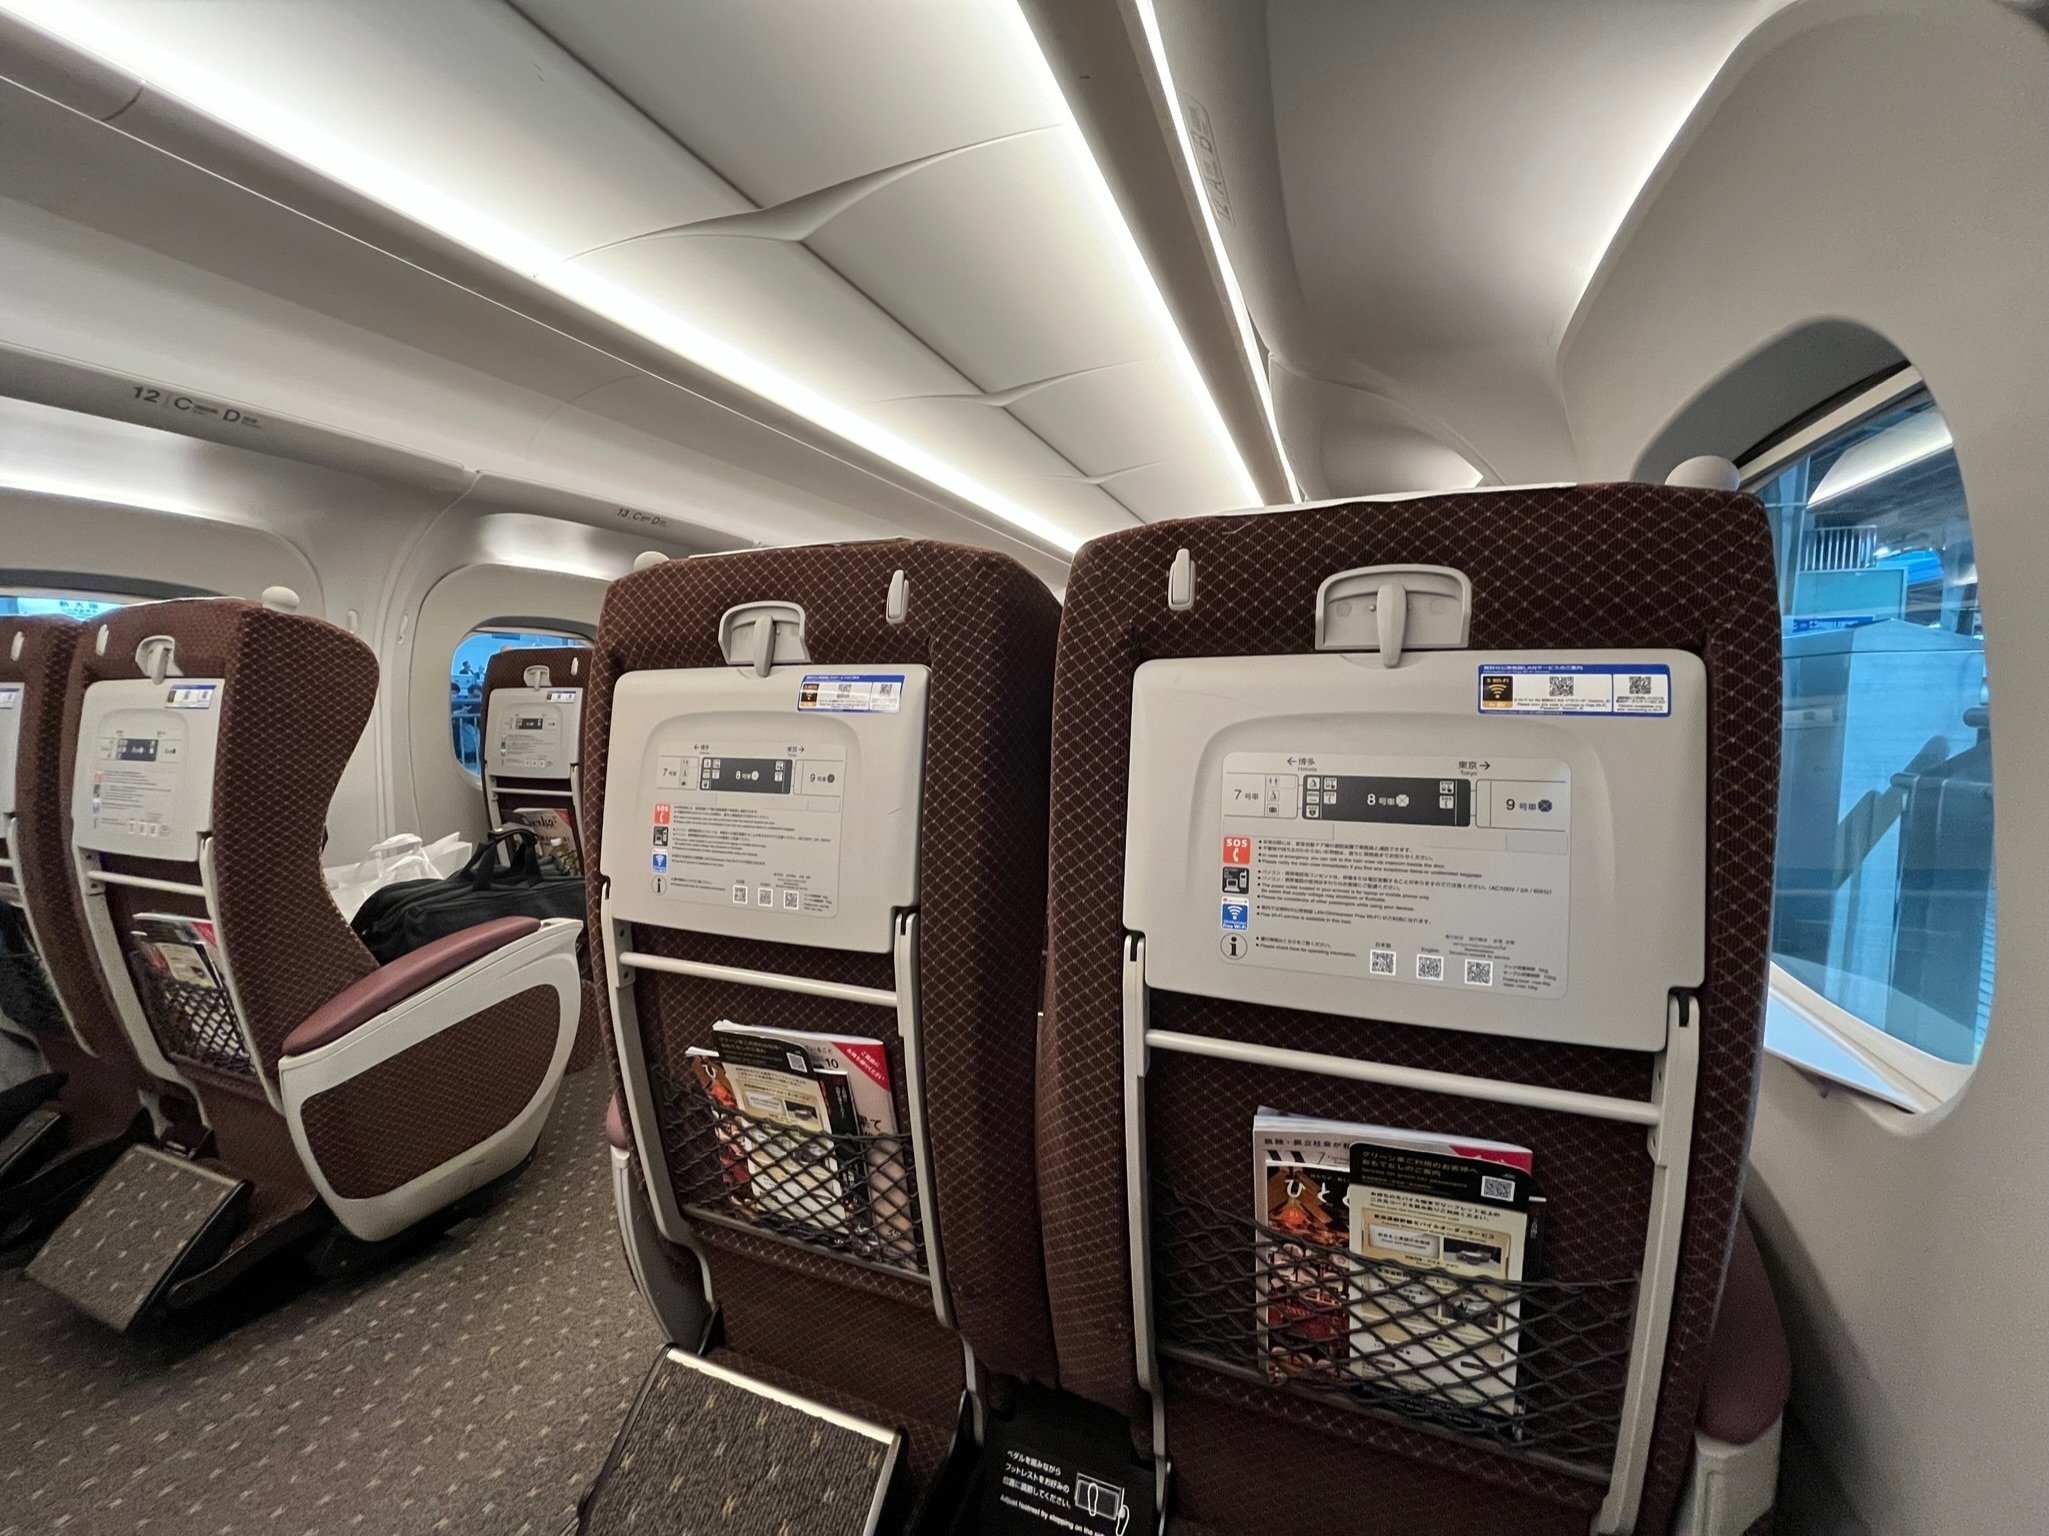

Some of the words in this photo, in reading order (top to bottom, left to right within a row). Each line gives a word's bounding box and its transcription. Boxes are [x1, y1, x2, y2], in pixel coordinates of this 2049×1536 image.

[134, 386, 160, 403] 12
[174, 396, 192, 410] C
[222, 408, 240, 422] D
[617, 508, 630, 517] 13
[633, 512, 642, 520] C
[651, 516, 660, 525] D
[1298, 757, 1315, 766] 博多
[1458, 760, 1477, 770] 東京
[662, 768, 668, 776] 7
[735, 770, 741, 780] 8
[810, 773, 816, 783] 9
[1234, 789, 1242, 800] 7
[1367, 794, 1376, 805] 8
[1506, 798, 1515, 810] 9
[826, 1058, 838, 1069] 10
[1040, 1510, 1049, 1520] by
